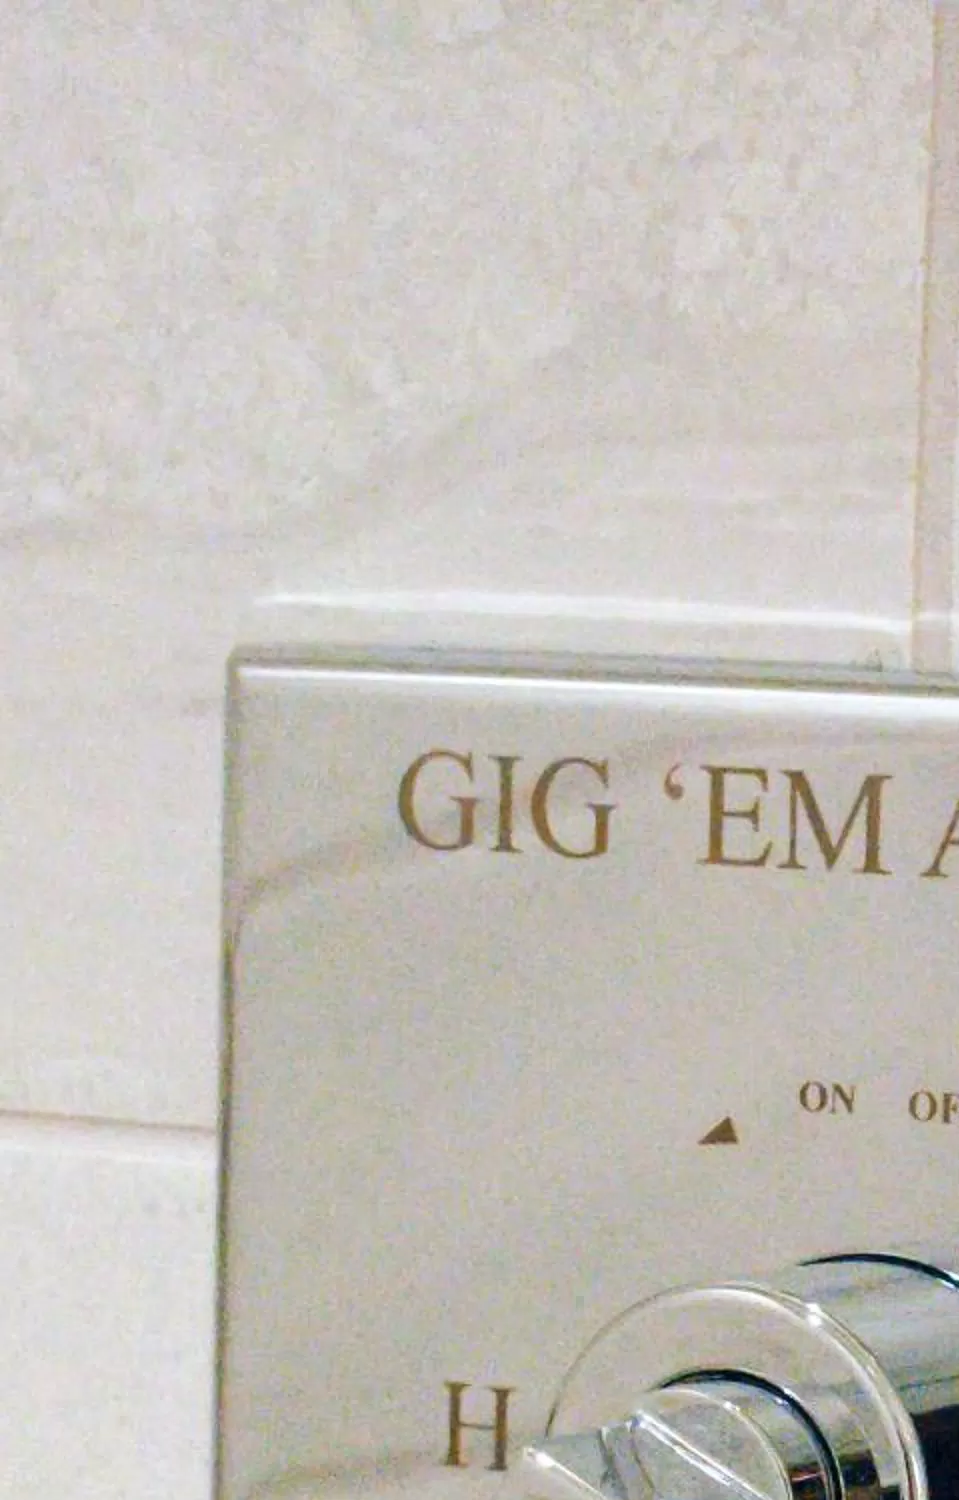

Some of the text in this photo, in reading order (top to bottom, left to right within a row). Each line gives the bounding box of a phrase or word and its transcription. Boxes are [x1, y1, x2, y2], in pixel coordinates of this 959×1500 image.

[396, 747, 617, 860] GIG
[798, 1079, 857, 1115] ON
[443, 1379, 517, 1472] H
